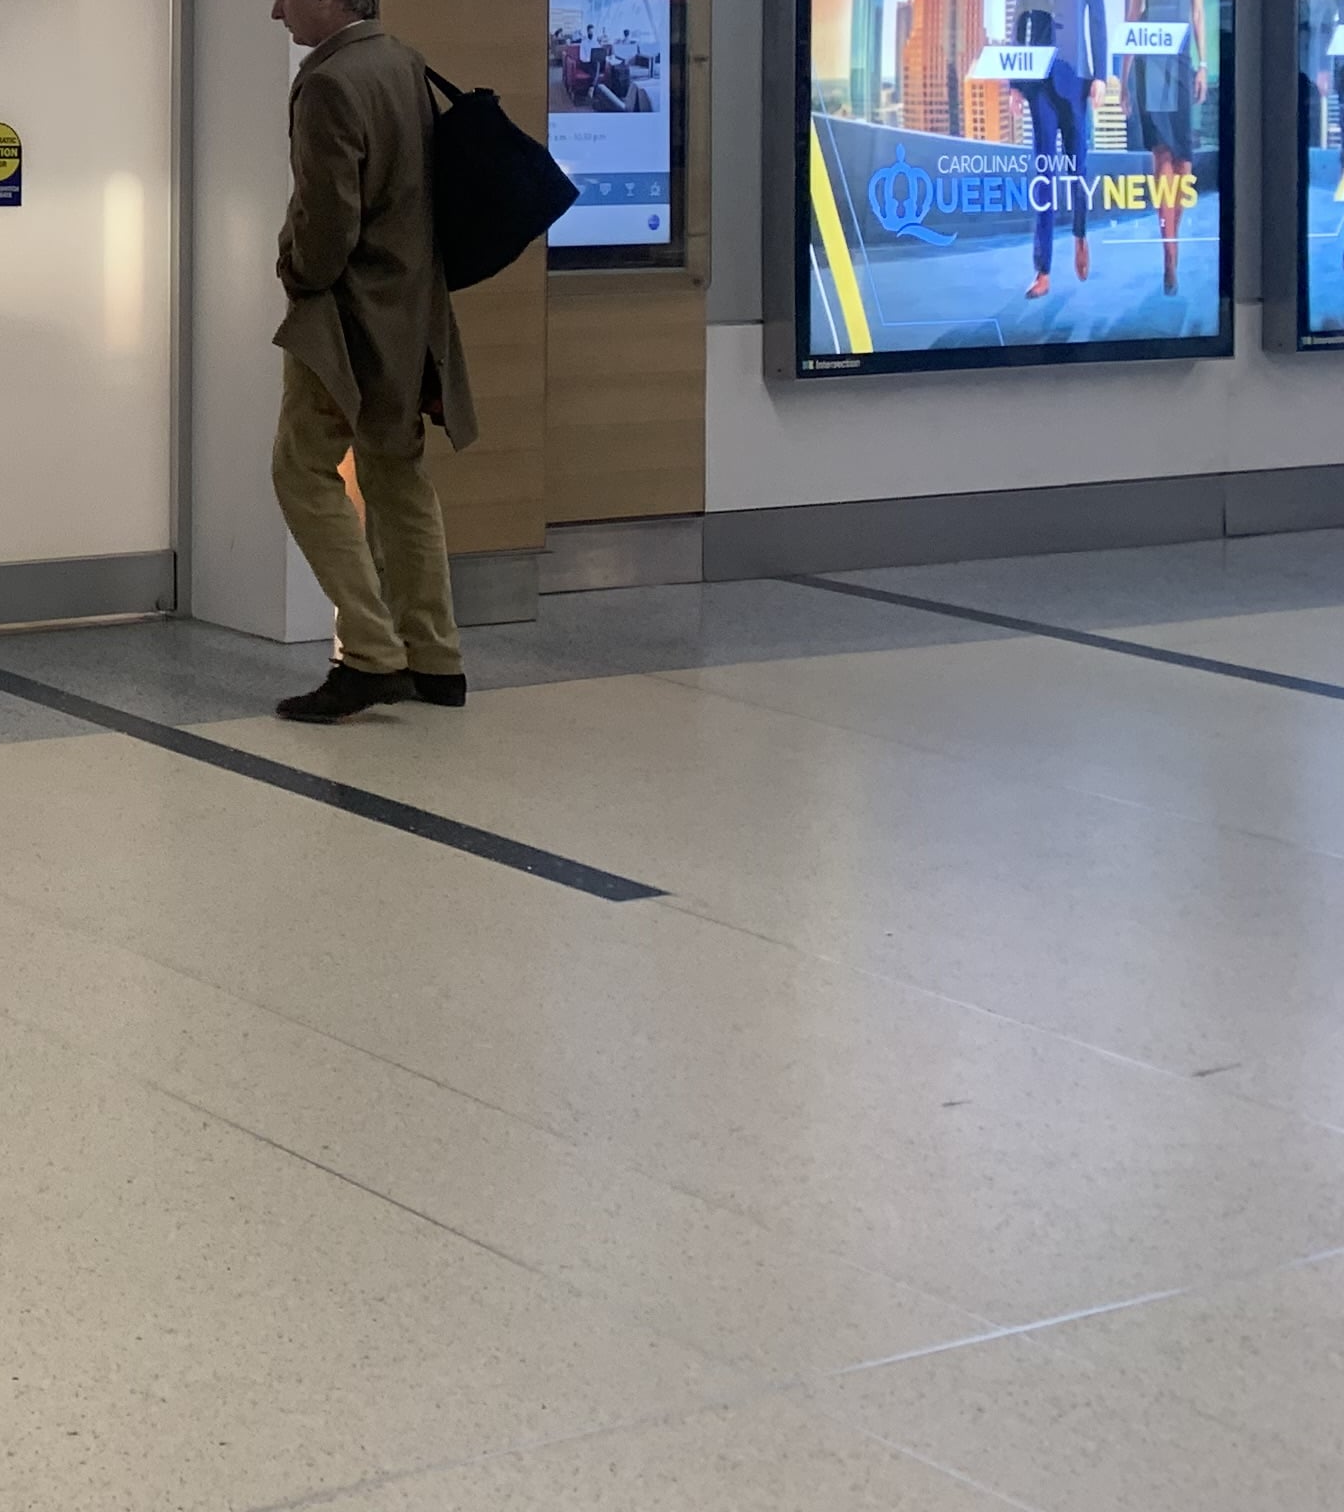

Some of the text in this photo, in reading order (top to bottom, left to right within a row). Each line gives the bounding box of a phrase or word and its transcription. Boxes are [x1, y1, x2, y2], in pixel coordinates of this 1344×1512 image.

[1125, 28, 1173, 47] Alicia
[999, 52, 1033, 71] Will
[1035, 153, 1077, 172] OWN
